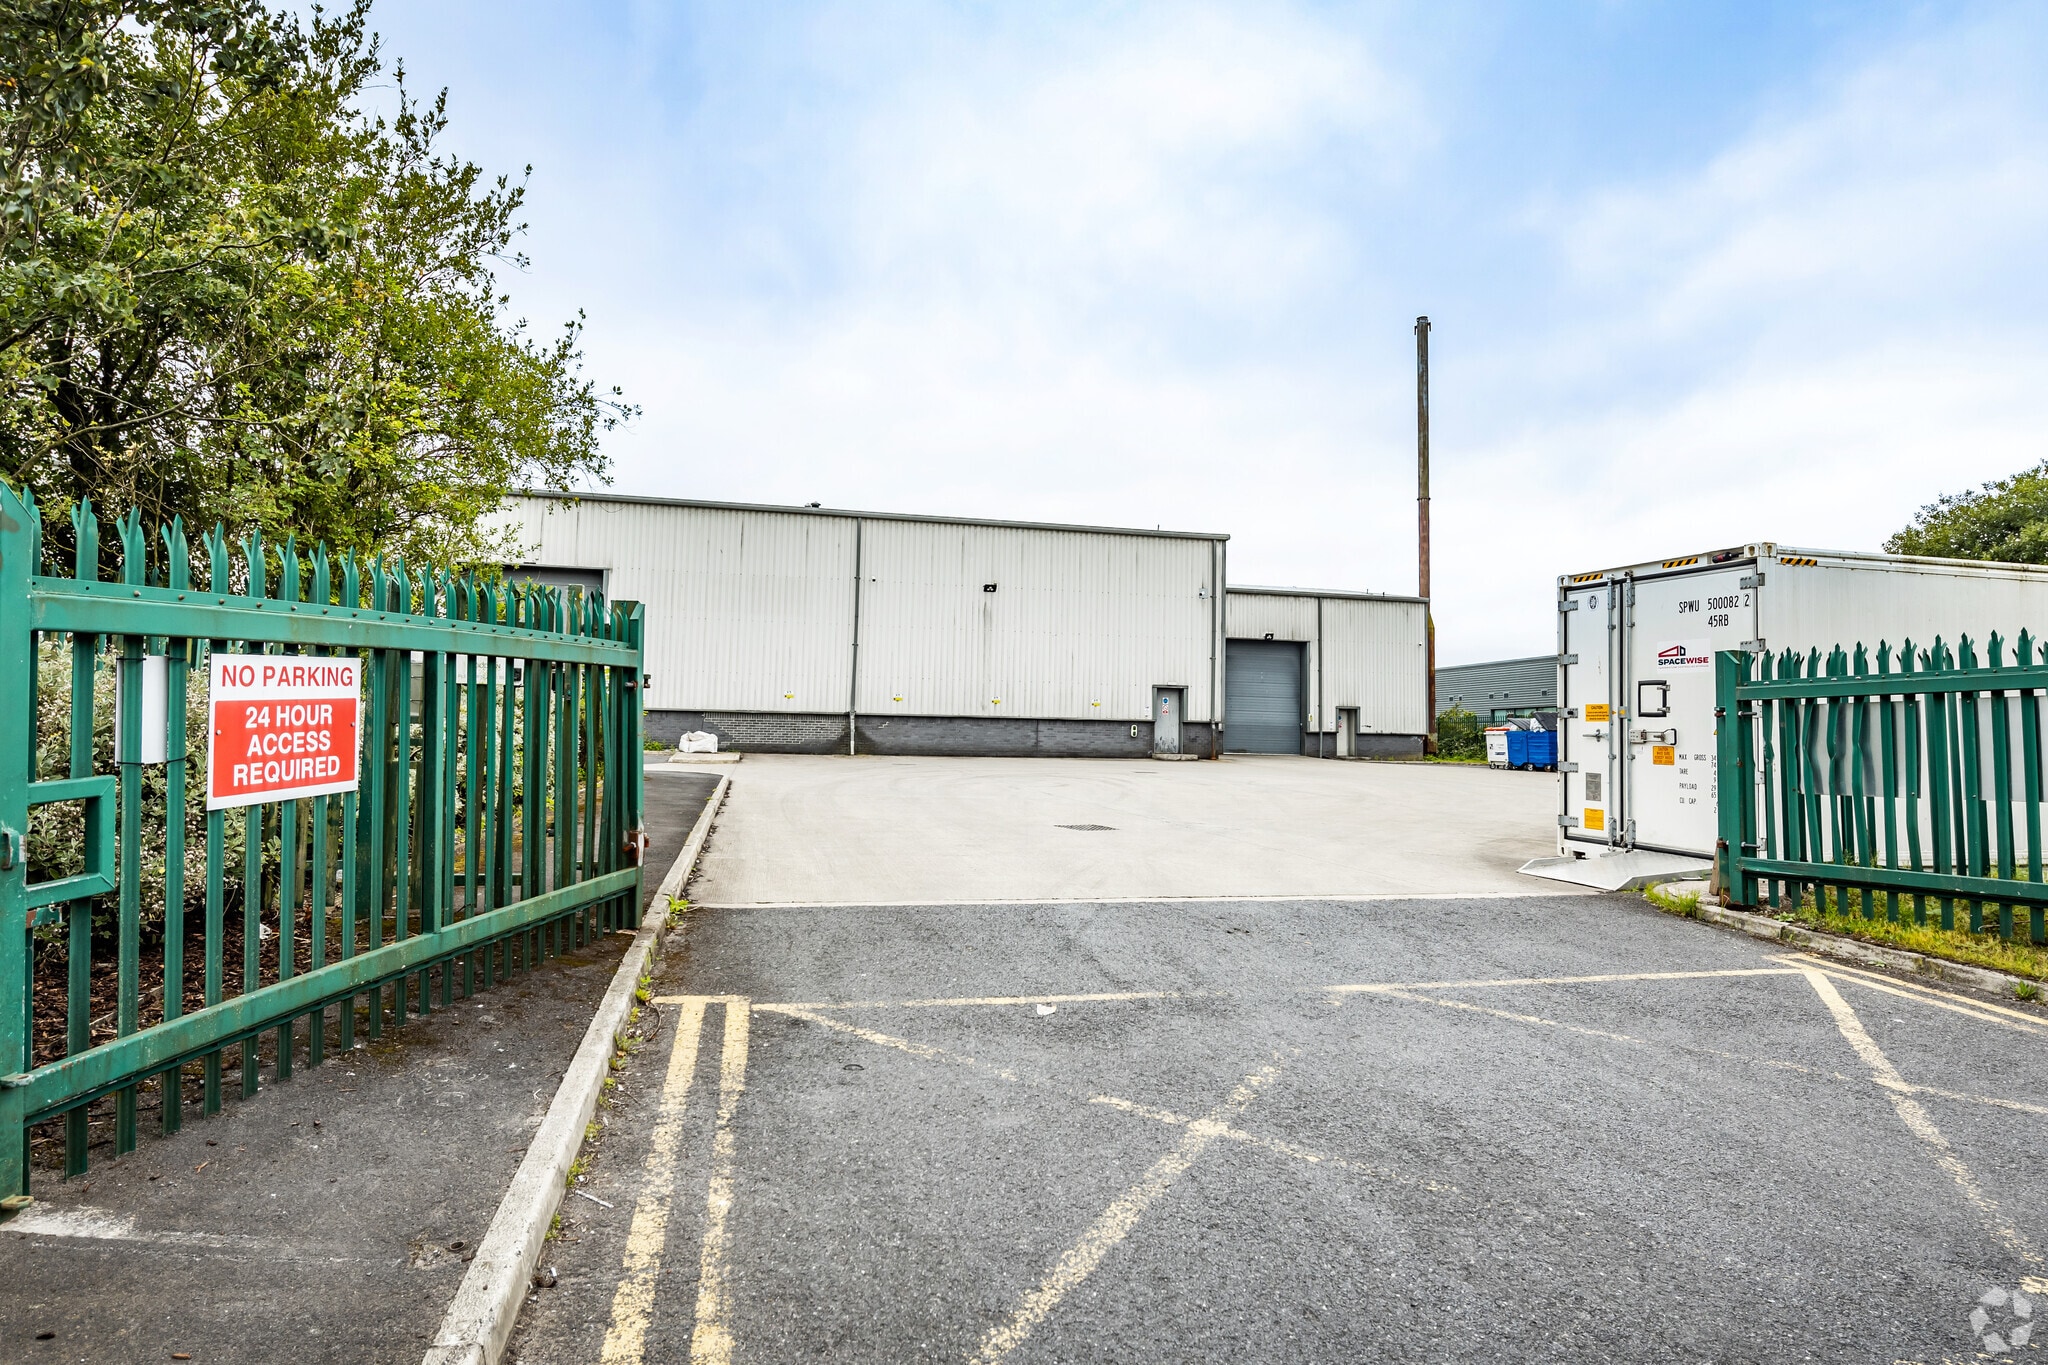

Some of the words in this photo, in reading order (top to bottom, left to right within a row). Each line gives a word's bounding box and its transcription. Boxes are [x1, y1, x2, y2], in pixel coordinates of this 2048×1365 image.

[1679, 599, 1700, 614] SPWU
[1707, 595, 1739, 610] 500082
[1744, 593, 1750, 607] 2
[1707, 613, 1729, 627] 45RB
[1658, 656, 1709, 665] SPACEWISE
[221, 665, 255, 688] NO
[263, 666, 353, 687] PARKING
[245, 706, 271, 729] 24
[275, 704, 333, 727] HOUR
[246, 730, 331, 757] ACCESS
[1694, 753, 1706, 761] GROSS
[233, 755, 340, 787] REQUIRED
[1679, 767, 1688, 775] TARE
[1679, 782, 1697, 790] PAYLOAD
